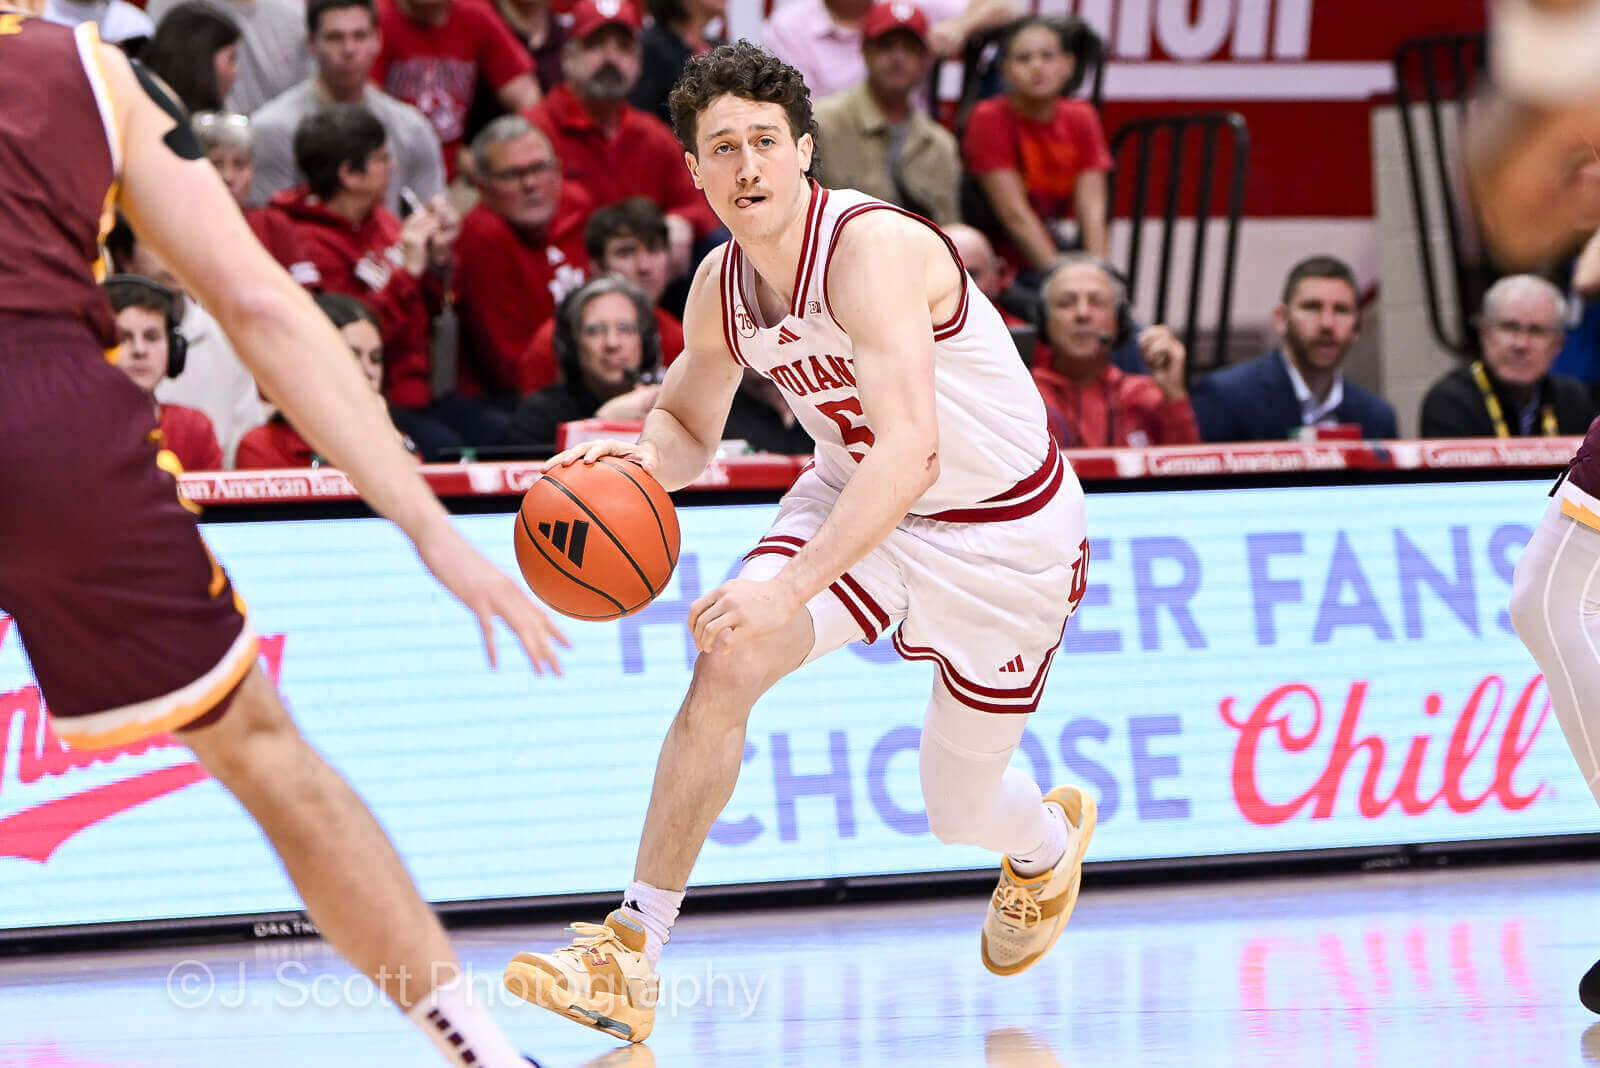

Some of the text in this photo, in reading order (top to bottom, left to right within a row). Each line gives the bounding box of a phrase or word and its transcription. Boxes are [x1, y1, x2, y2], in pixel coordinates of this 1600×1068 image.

[815, 396, 875, 464] 5
[213, 477, 308, 498] American
[1218, 672, 1552, 827] Chill
